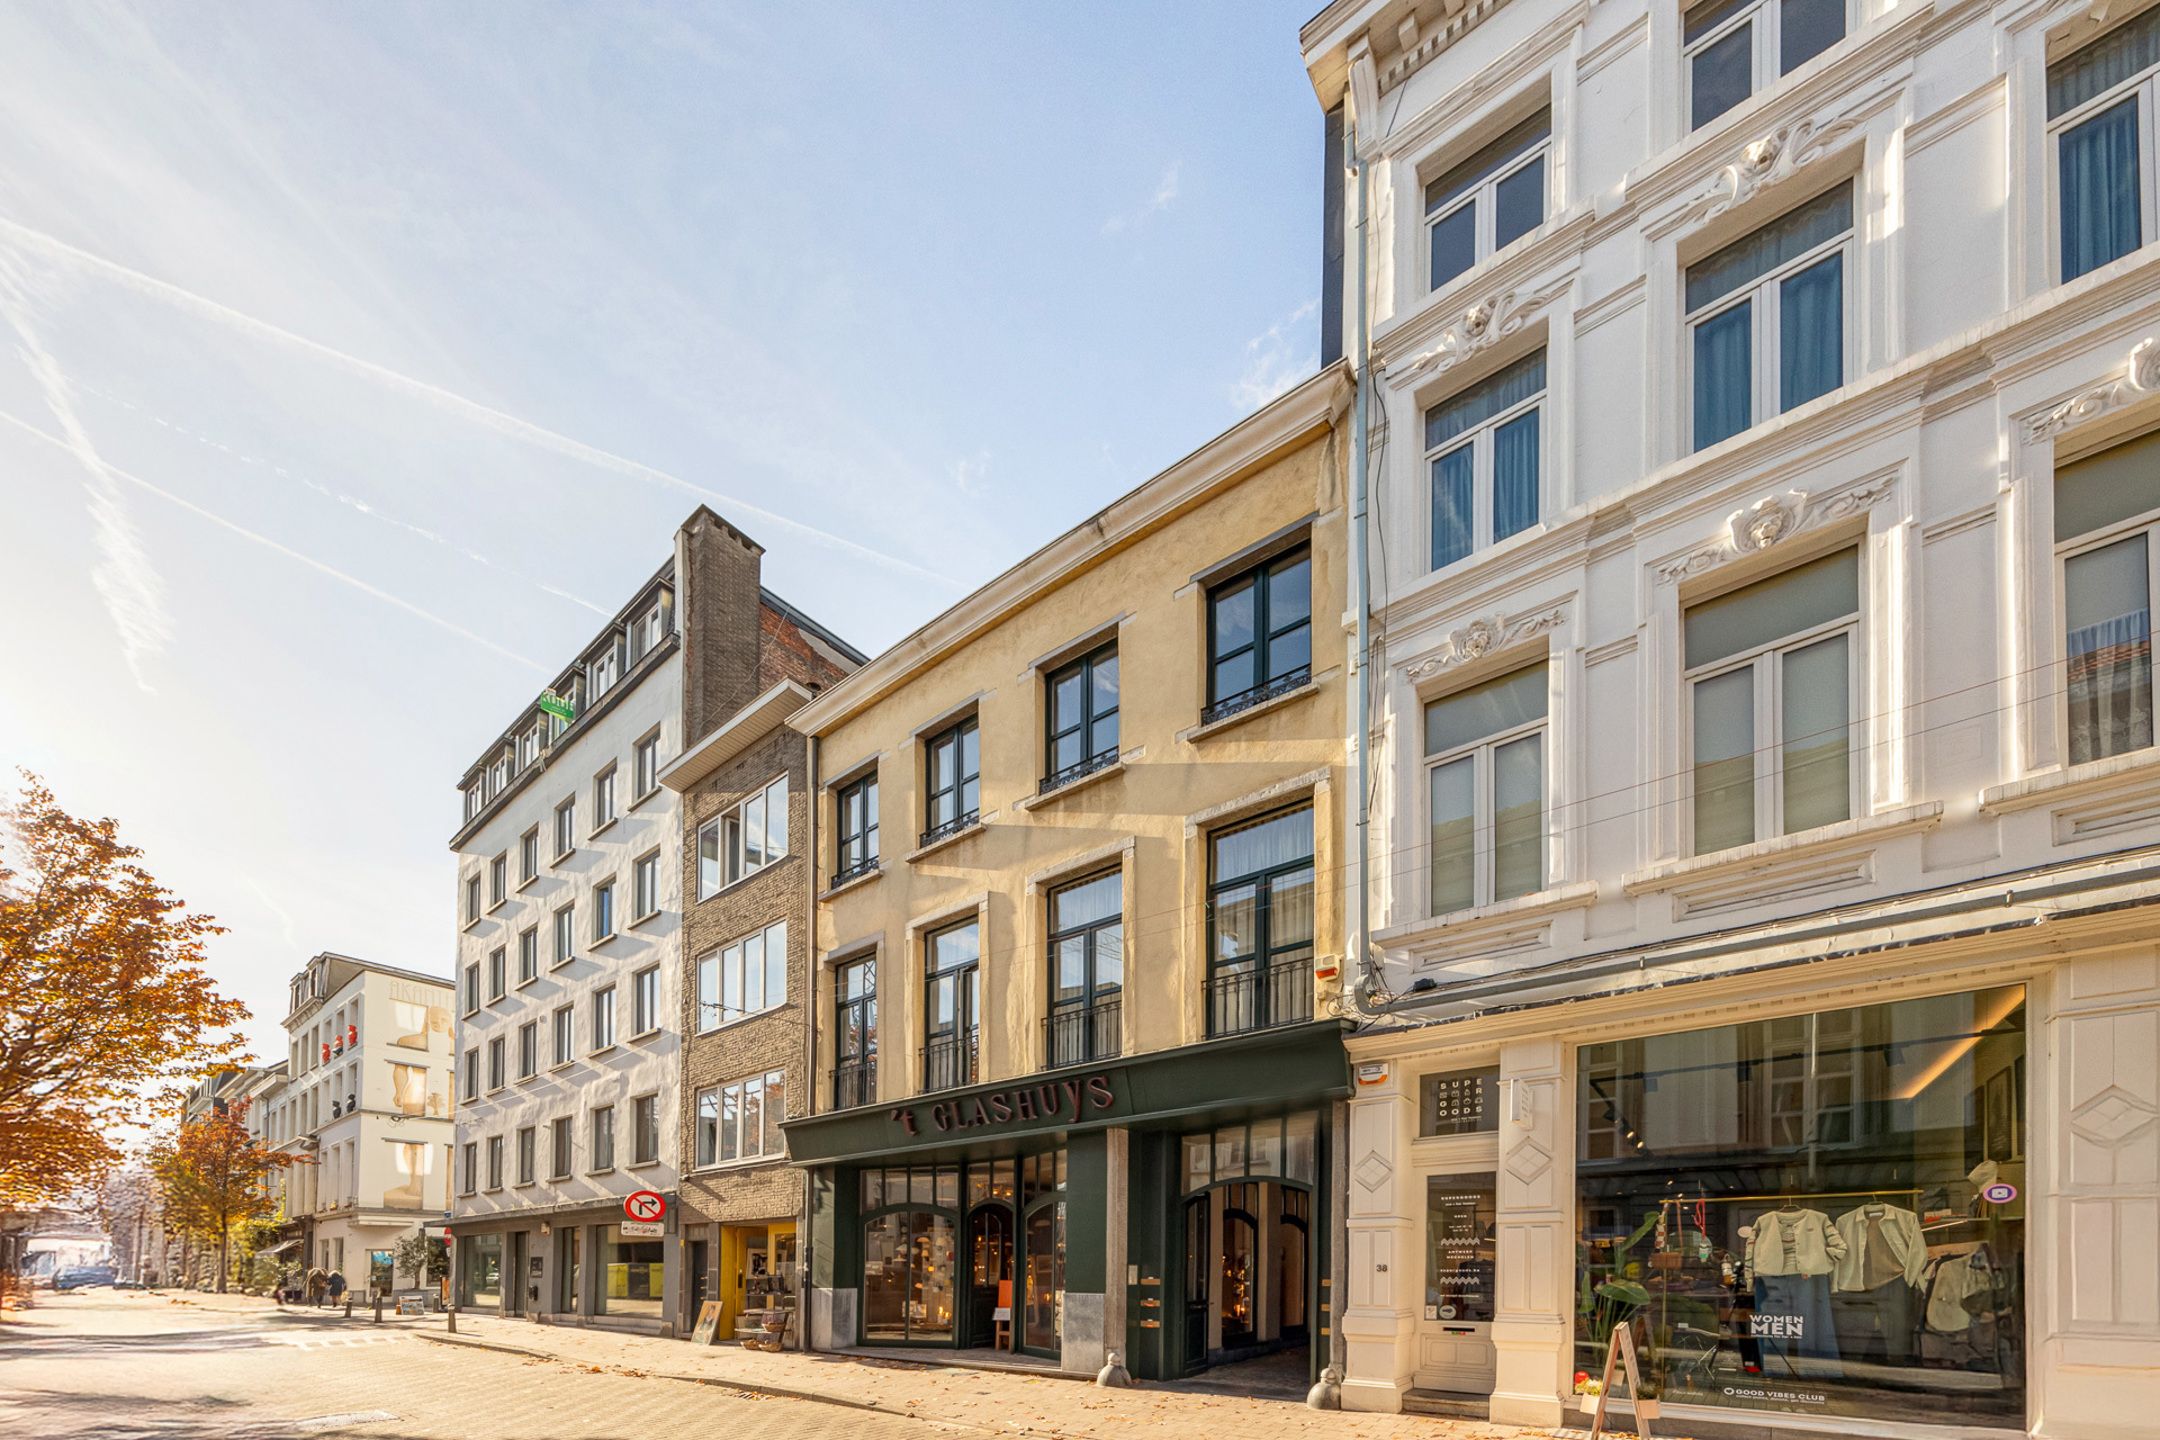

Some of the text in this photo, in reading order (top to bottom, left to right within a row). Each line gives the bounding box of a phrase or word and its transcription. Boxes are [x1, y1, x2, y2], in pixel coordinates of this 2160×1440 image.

[1376, 1264, 1388, 1273] 38
[1749, 1314, 1804, 1323] WOMEN
[1750, 1321, 1803, 1336] MEN
[1736, 1388, 1765, 1396] GOOD
[1766, 1391, 1796, 1399] VIBES
